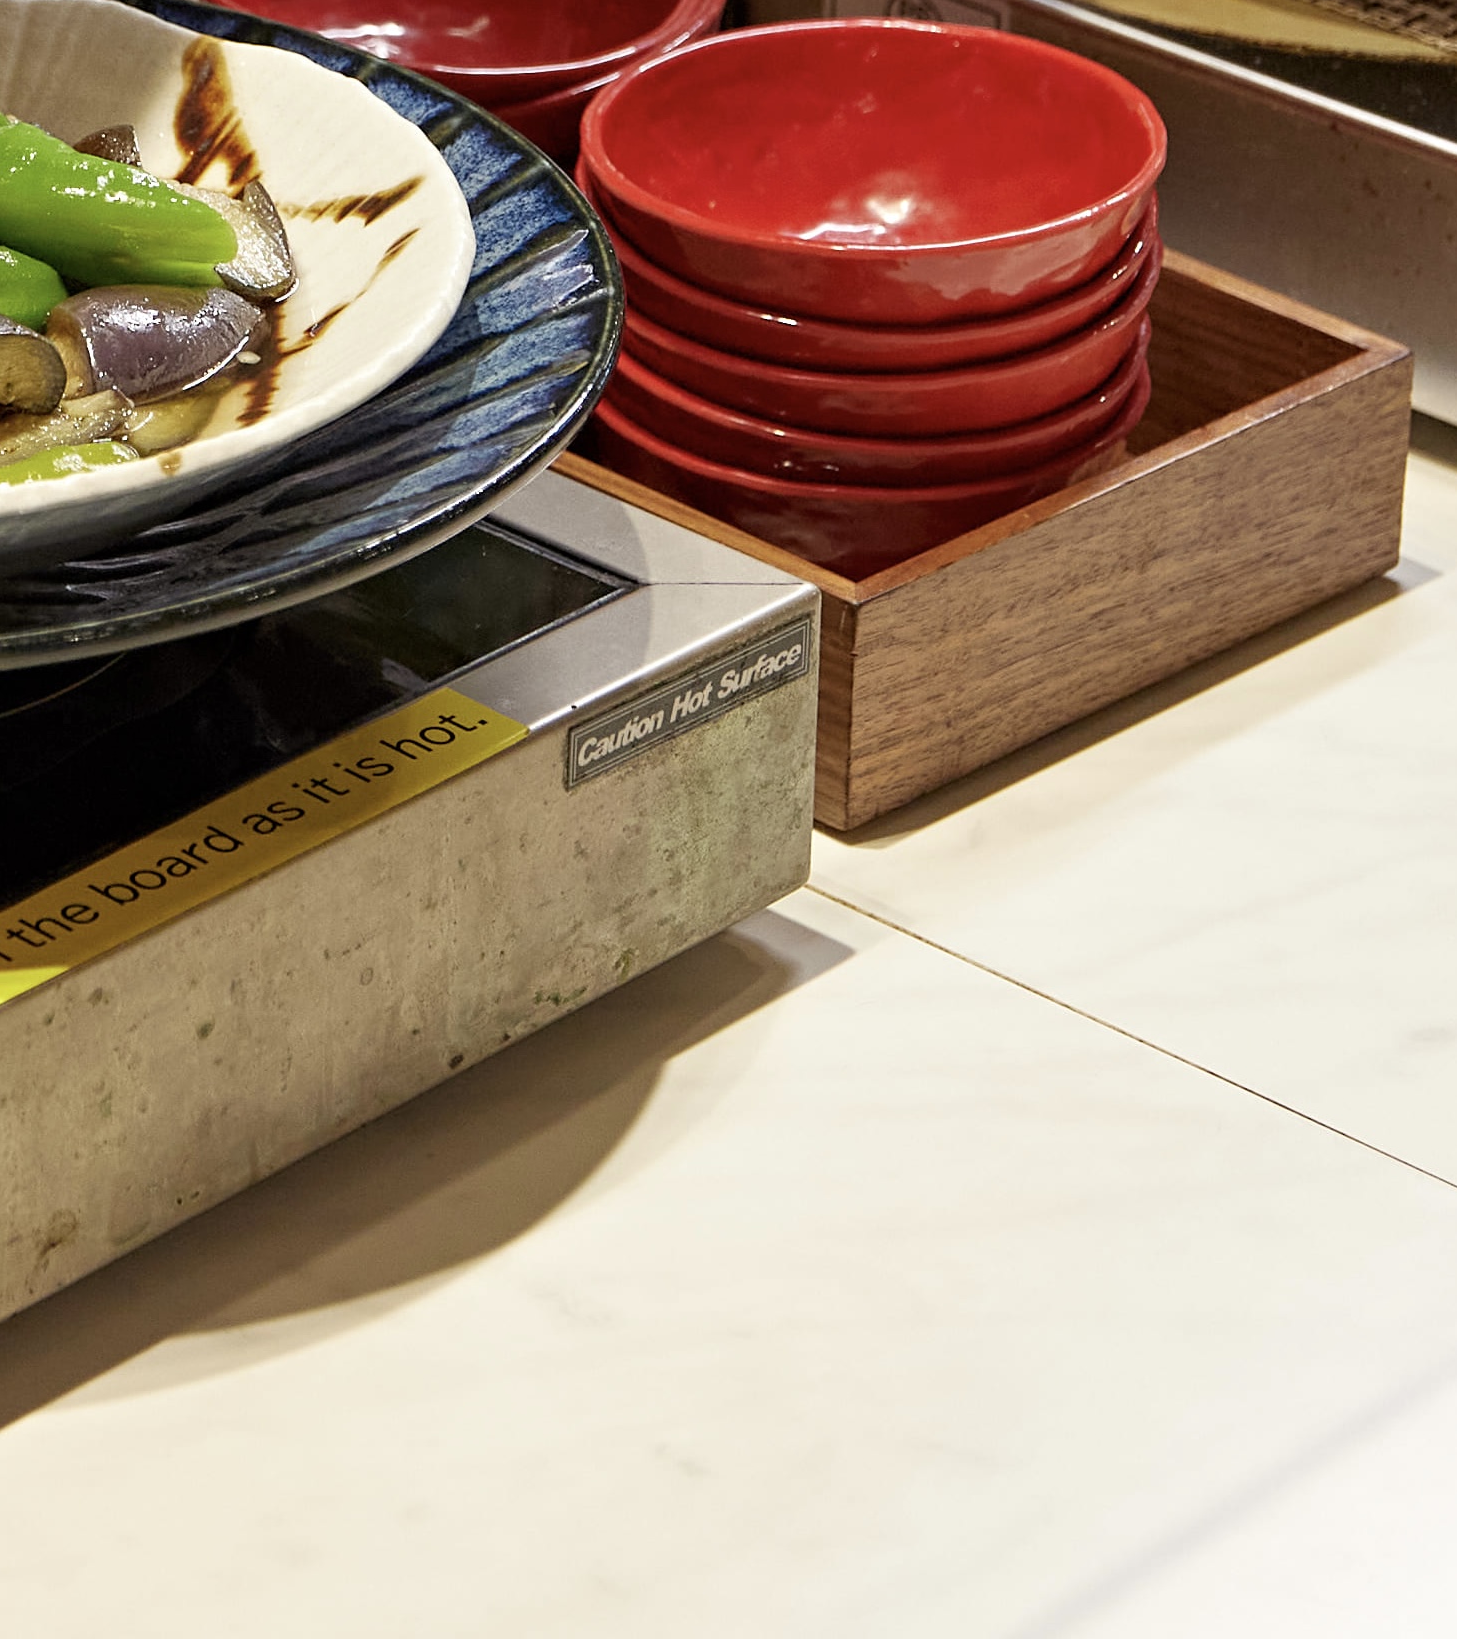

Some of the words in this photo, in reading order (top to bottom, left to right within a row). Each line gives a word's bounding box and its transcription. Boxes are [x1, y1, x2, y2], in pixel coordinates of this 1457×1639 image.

[578, 708, 665, 767] Caution
[670, 680, 713, 723] Hot
[717, 642, 802, 699] Surface
[5, 900, 101, 949] the
[88, 824, 246, 907] board
[241, 799, 306, 836] as
[291, 774, 351, 805] it
[332, 754, 395, 783] is
[379, 712, 490, 761] hot.
